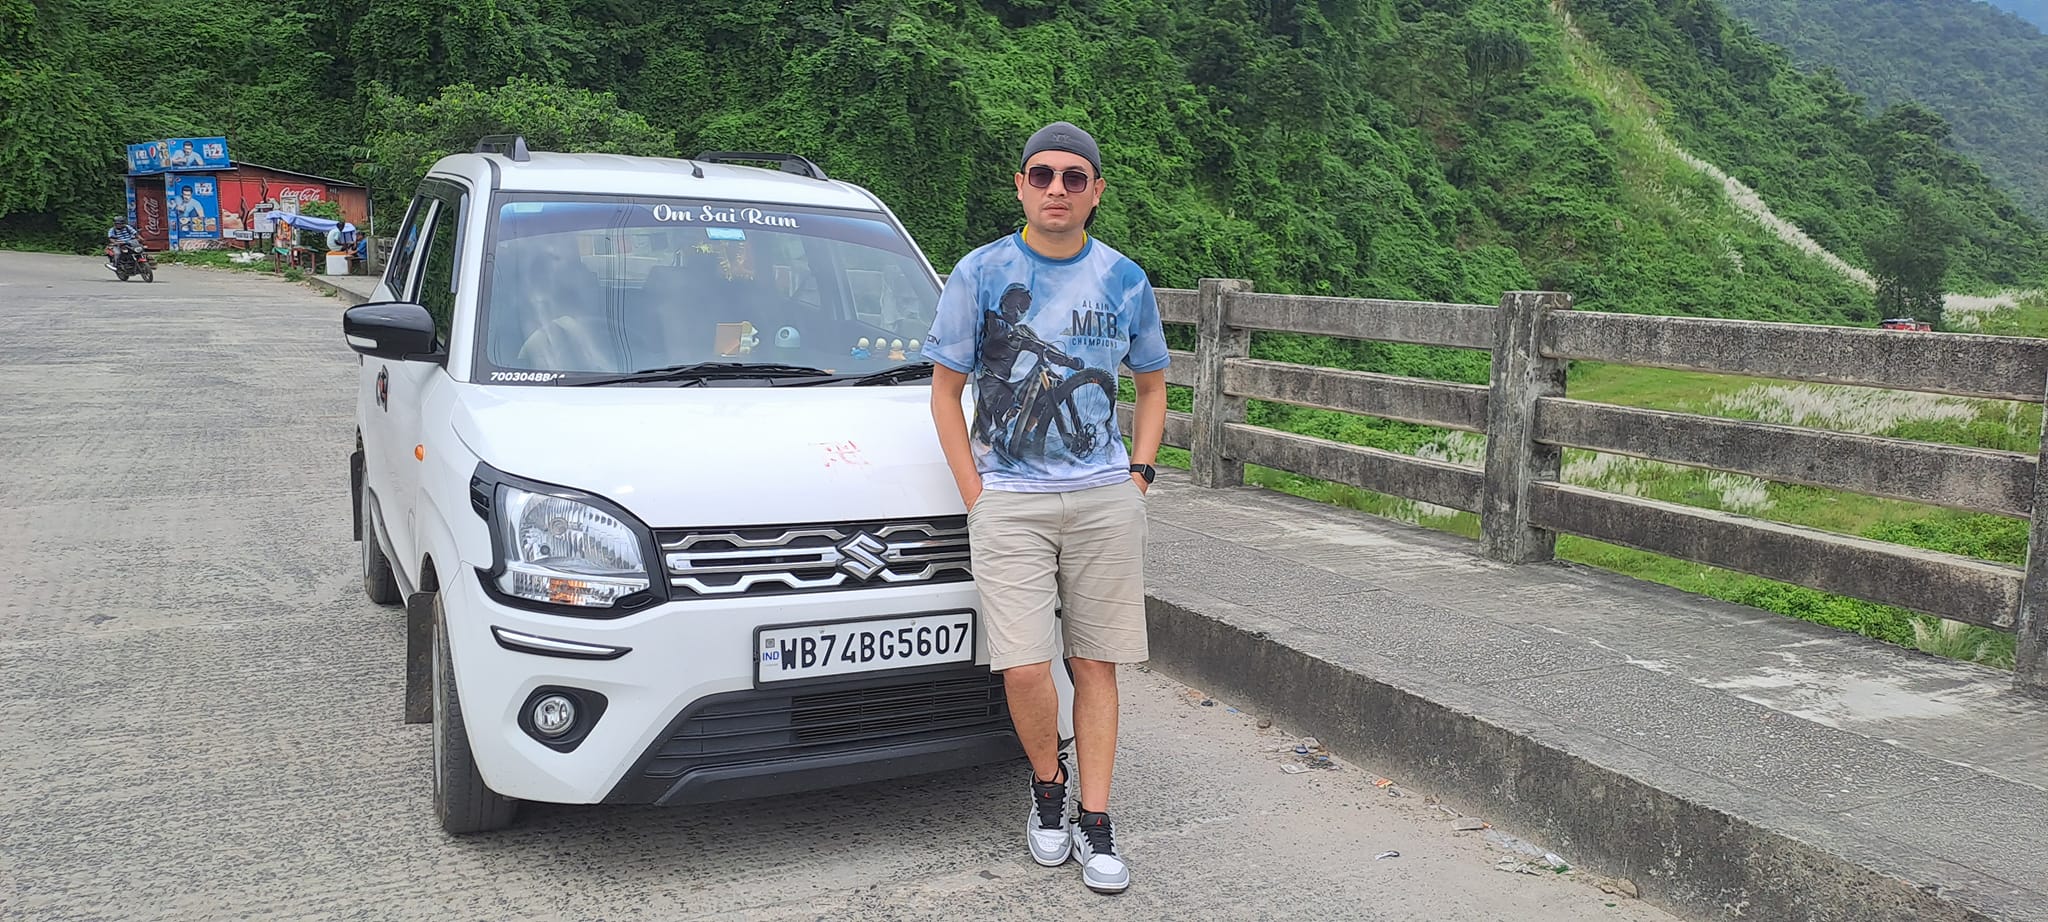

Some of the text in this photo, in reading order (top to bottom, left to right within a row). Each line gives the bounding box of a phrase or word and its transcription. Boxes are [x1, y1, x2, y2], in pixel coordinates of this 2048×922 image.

[653, 204, 799, 229] Om Sai Ram
[1072, 309, 1117, 338] MTB
[762, 623, 969, 670] IND WB74BG5607
